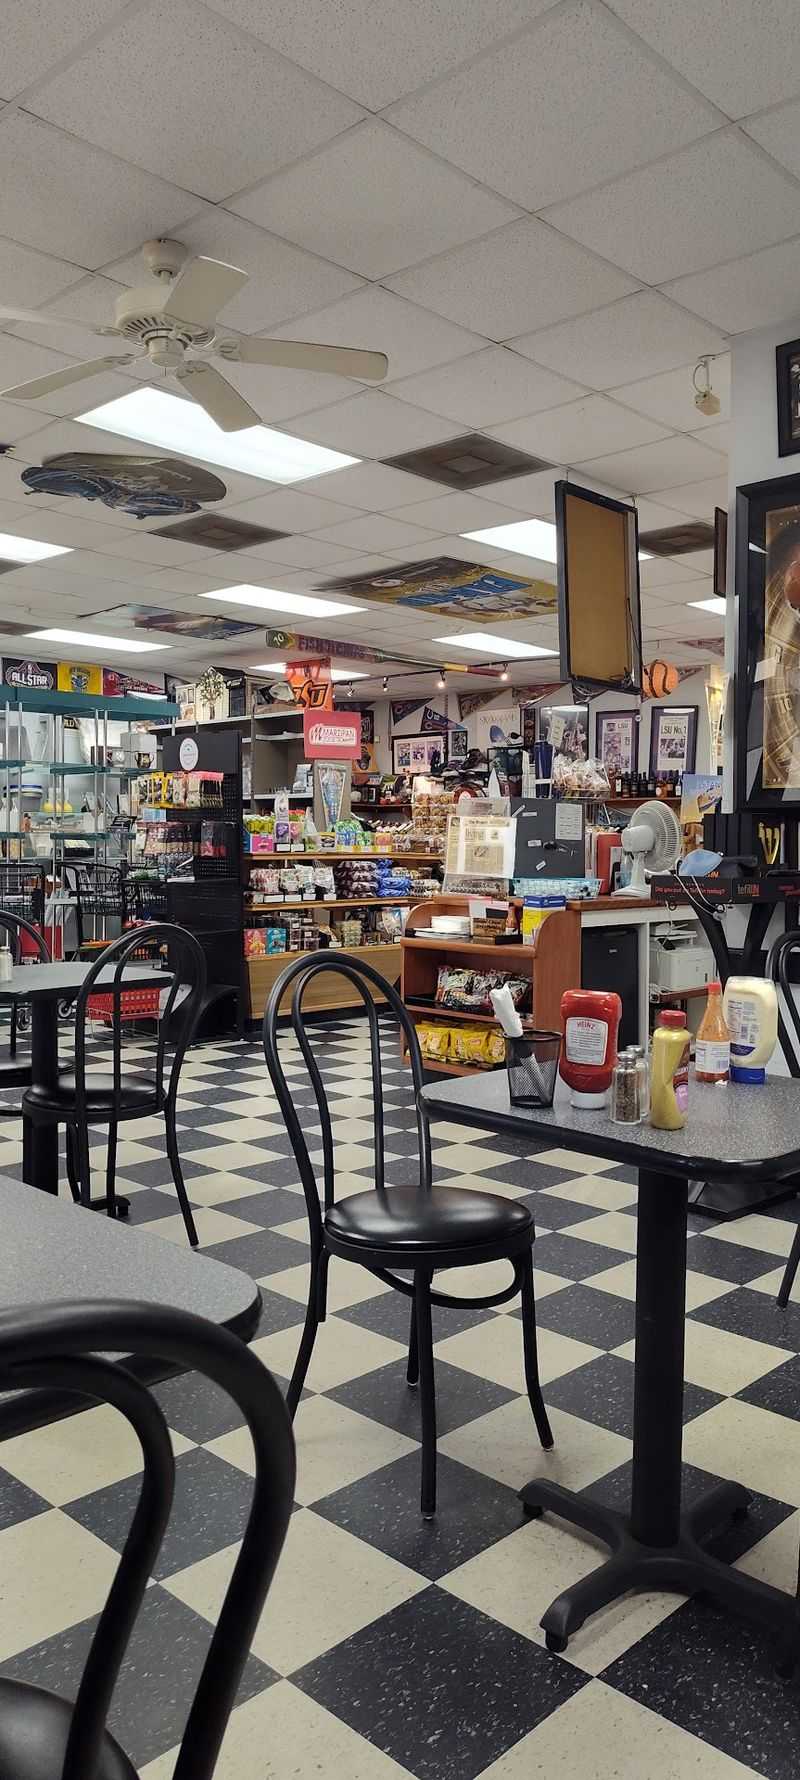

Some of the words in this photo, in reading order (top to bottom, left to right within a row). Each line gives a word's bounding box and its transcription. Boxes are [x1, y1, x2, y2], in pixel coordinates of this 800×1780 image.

[27, 674, 48, 686] STAR
[660, 726, 672, 735] LSU
[576, 1020, 596, 1030] HEINZ
